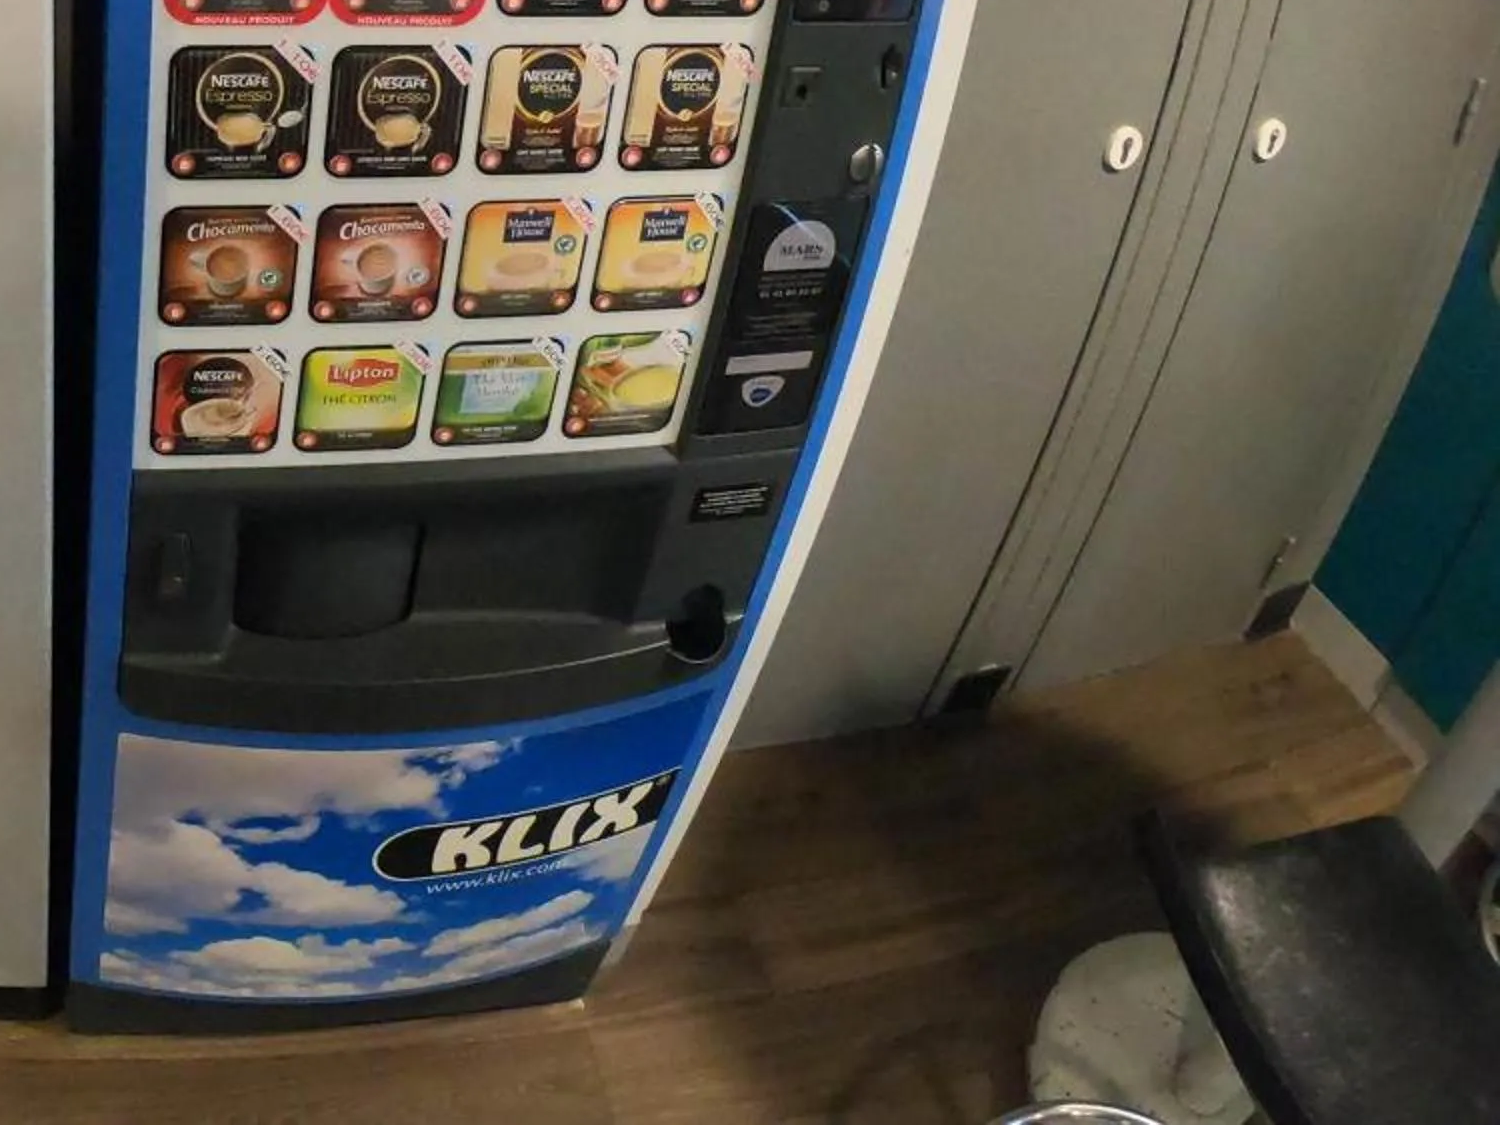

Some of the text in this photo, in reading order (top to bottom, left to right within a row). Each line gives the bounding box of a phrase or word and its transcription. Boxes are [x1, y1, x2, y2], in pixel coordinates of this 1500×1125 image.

[205, 88, 273, 105] Espresso
[366, 90, 431, 106] Espresso
[331, 364, 396, 383] Lipton
[431, 780, 655, 874] KLIX
[426, 859, 566, 895] www.klix.com
